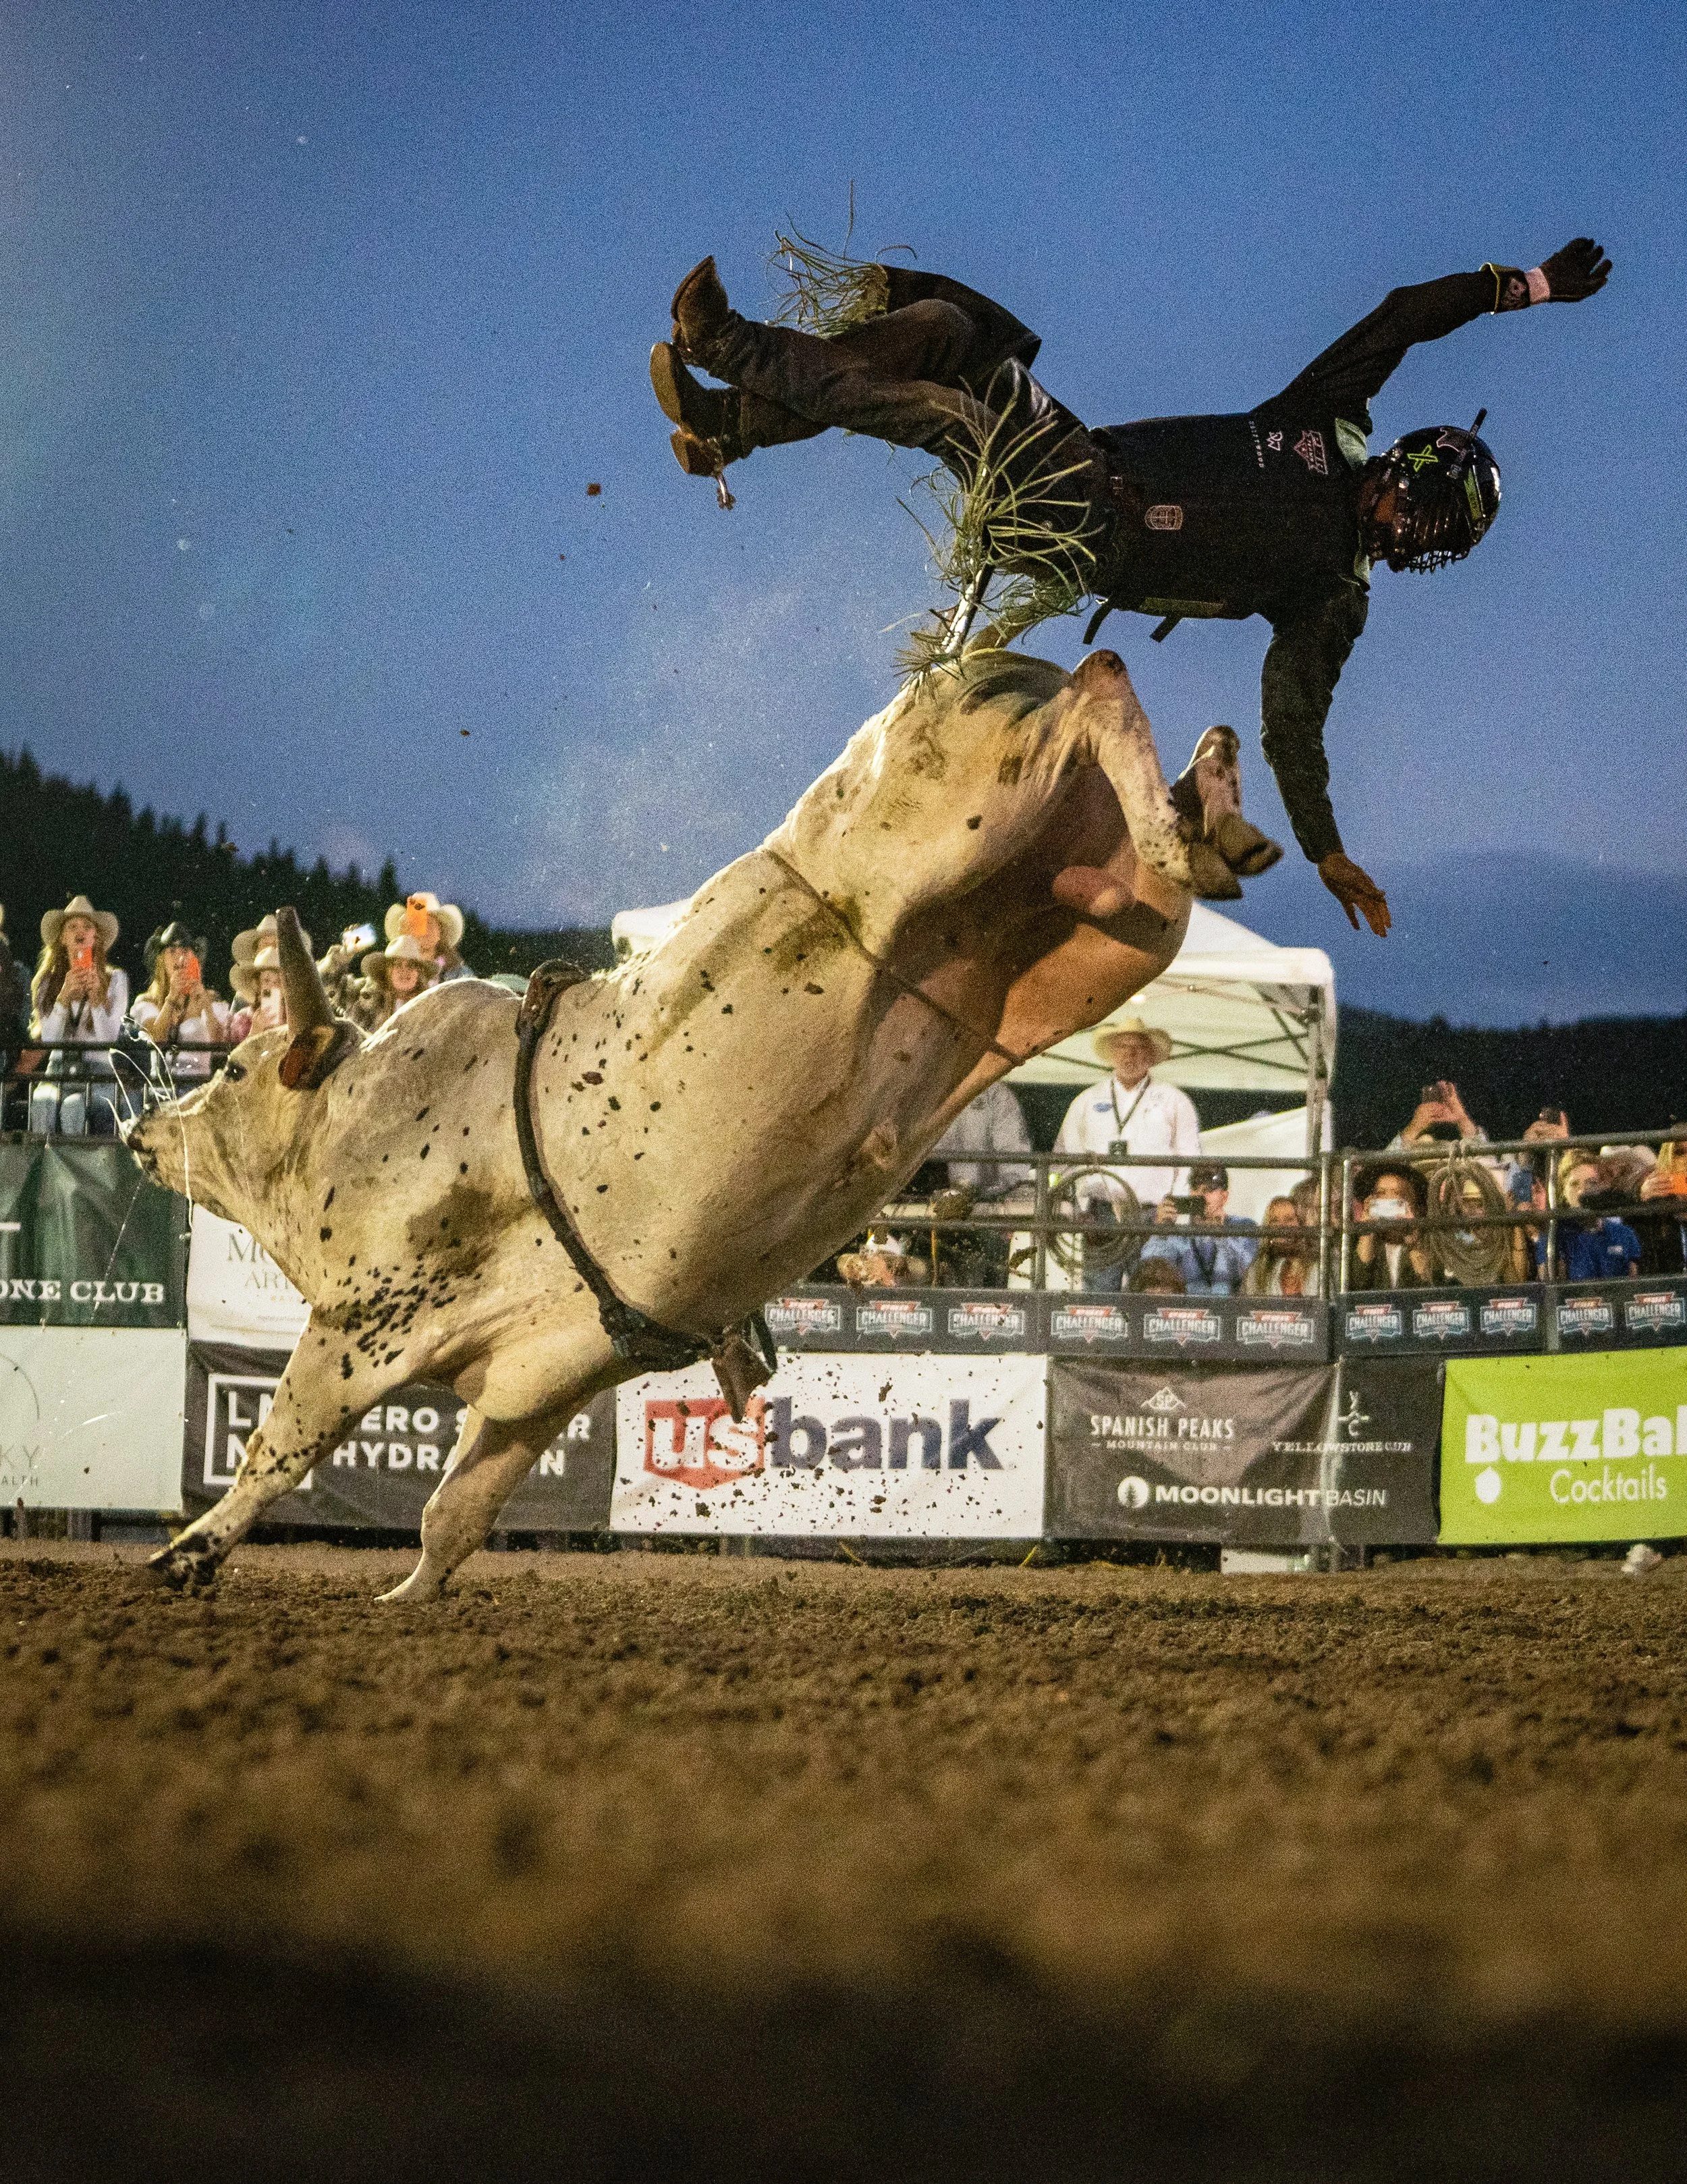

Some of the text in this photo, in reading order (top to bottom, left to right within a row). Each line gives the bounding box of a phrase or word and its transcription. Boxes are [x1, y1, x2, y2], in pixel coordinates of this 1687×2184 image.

[70, 1280, 164, 1303] CLUB
[360, 1405, 439, 1432] ERO
[1090, 1415, 1234, 1440] SPANISH PEAKS
[771, 1396, 1004, 1470] bank
[1106, 1440, 1217, 1451] MOUNTAIN CLUB
[1464, 1405, 1687, 1464] BuzzBal
[1272, 1441, 1383, 1452] YELLOWSTONE
[1155, 1485, 1387, 1506] MOONLIGHT BASIN
[1550, 1463, 1667, 1504] Cocktails
